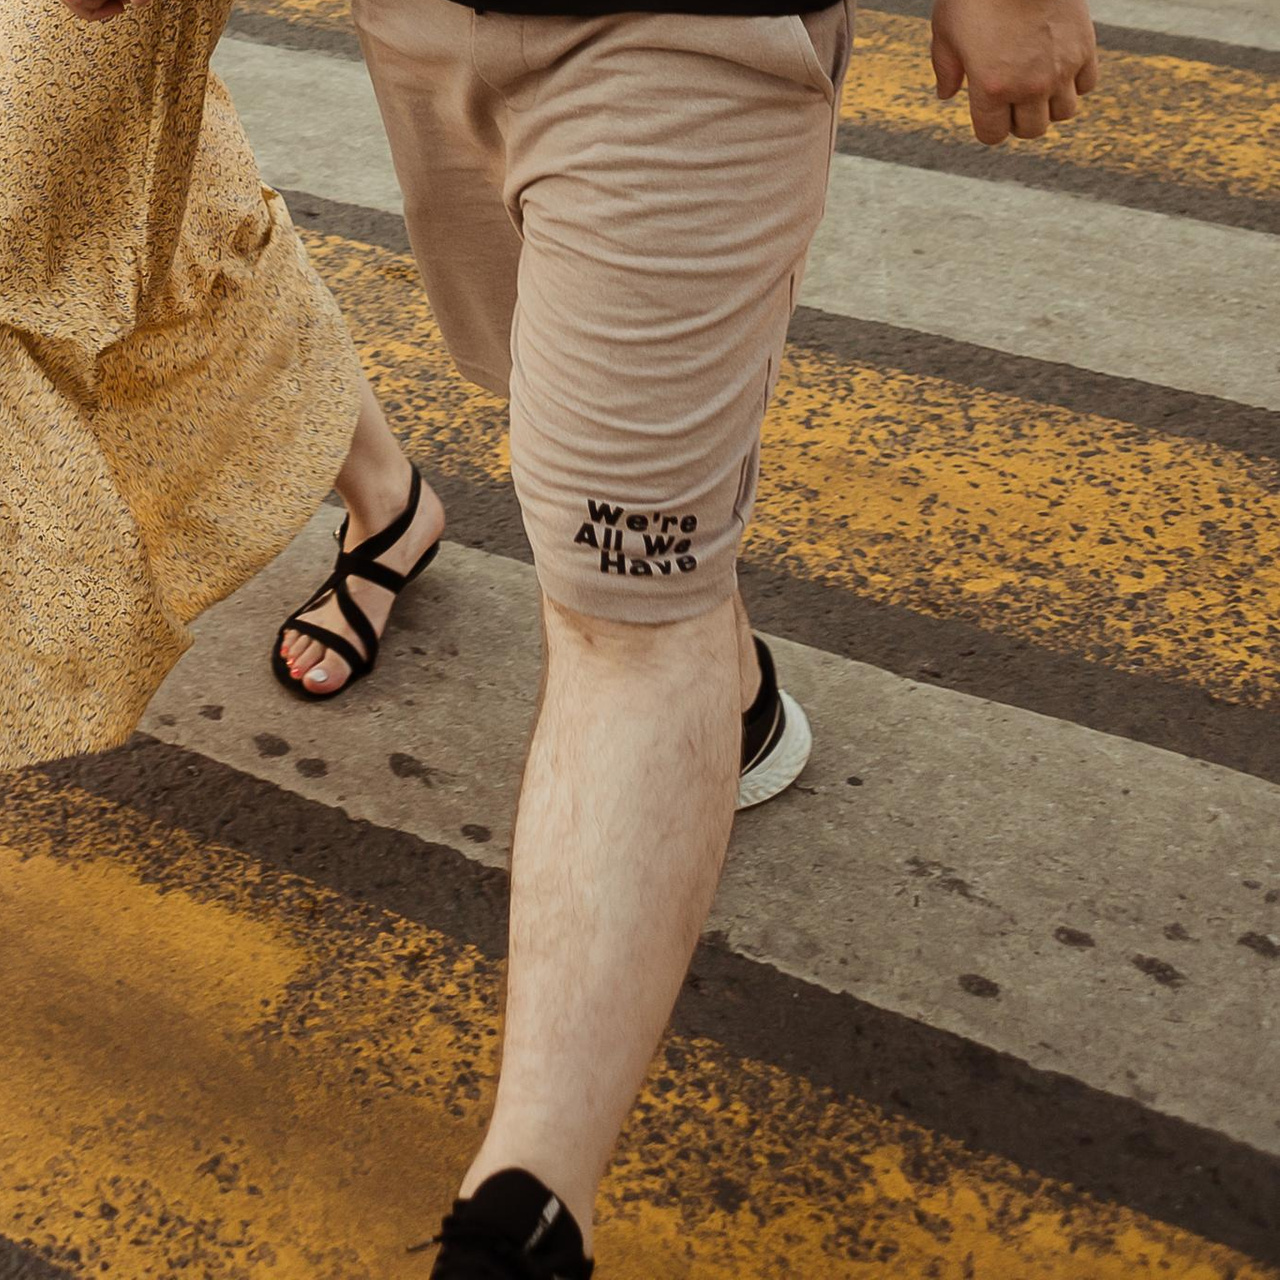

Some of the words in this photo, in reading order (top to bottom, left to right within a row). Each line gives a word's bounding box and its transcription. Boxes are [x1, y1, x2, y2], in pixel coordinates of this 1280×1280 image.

[587, 499, 697, 533] We're
[574, 522, 623, 552] All
[643, 534, 692, 556] We
[600, 550, 697, 576] Have
